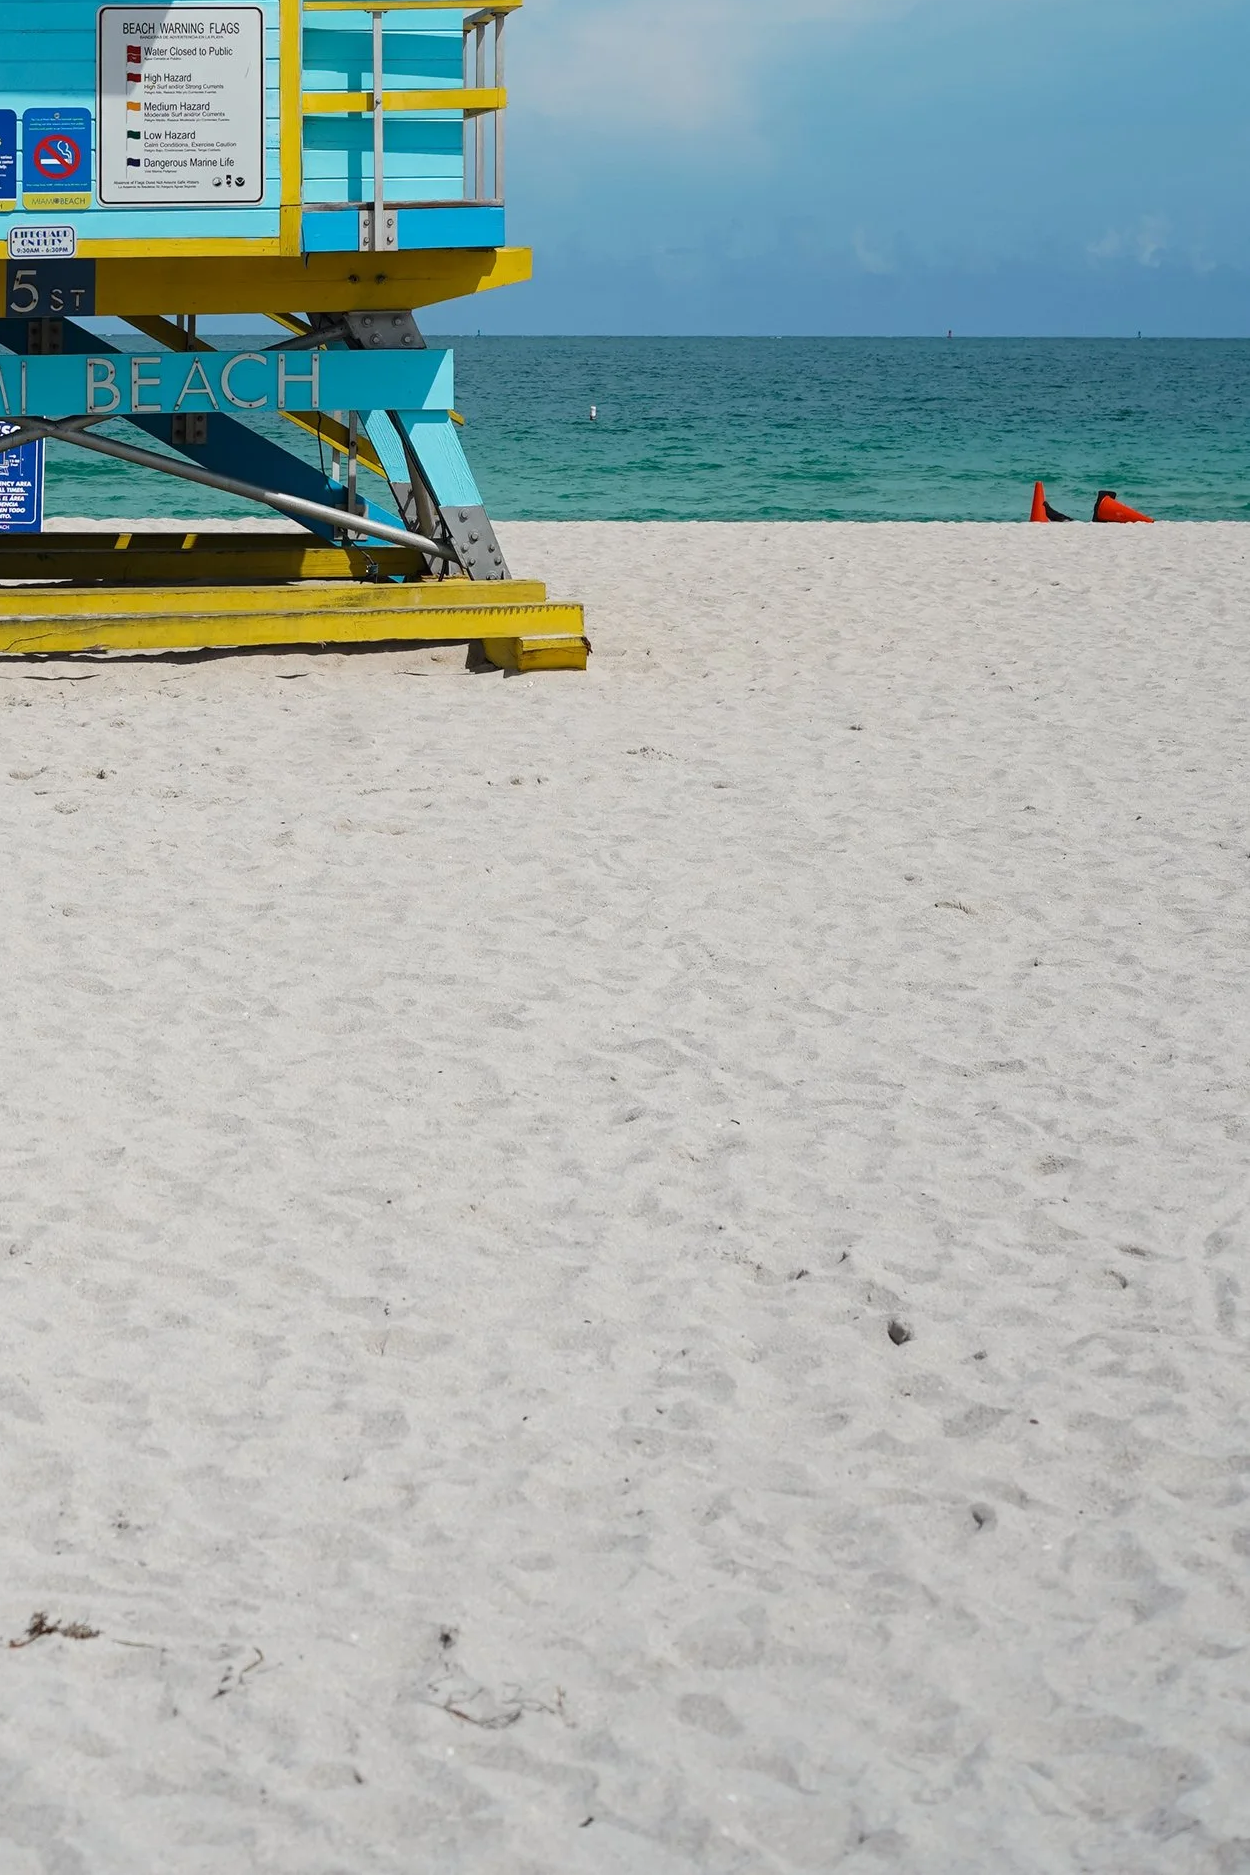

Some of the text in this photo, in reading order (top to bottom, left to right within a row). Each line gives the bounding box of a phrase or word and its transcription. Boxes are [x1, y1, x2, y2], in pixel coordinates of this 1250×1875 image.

[123, 22, 240, 34] BEACH WARNING FLAGS
[144, 46, 233, 56] Water Closed to Public
[144, 74, 192, 84] High Hazard
[144, 102, 210, 110] Medium Hazard
[144, 131, 196, 140] Low Hazard
[144, 157, 234, 169] Dangerous Marine Life
[10, 270, 85, 312] 5 ST
[86, 353, 320, 413] BEACH
